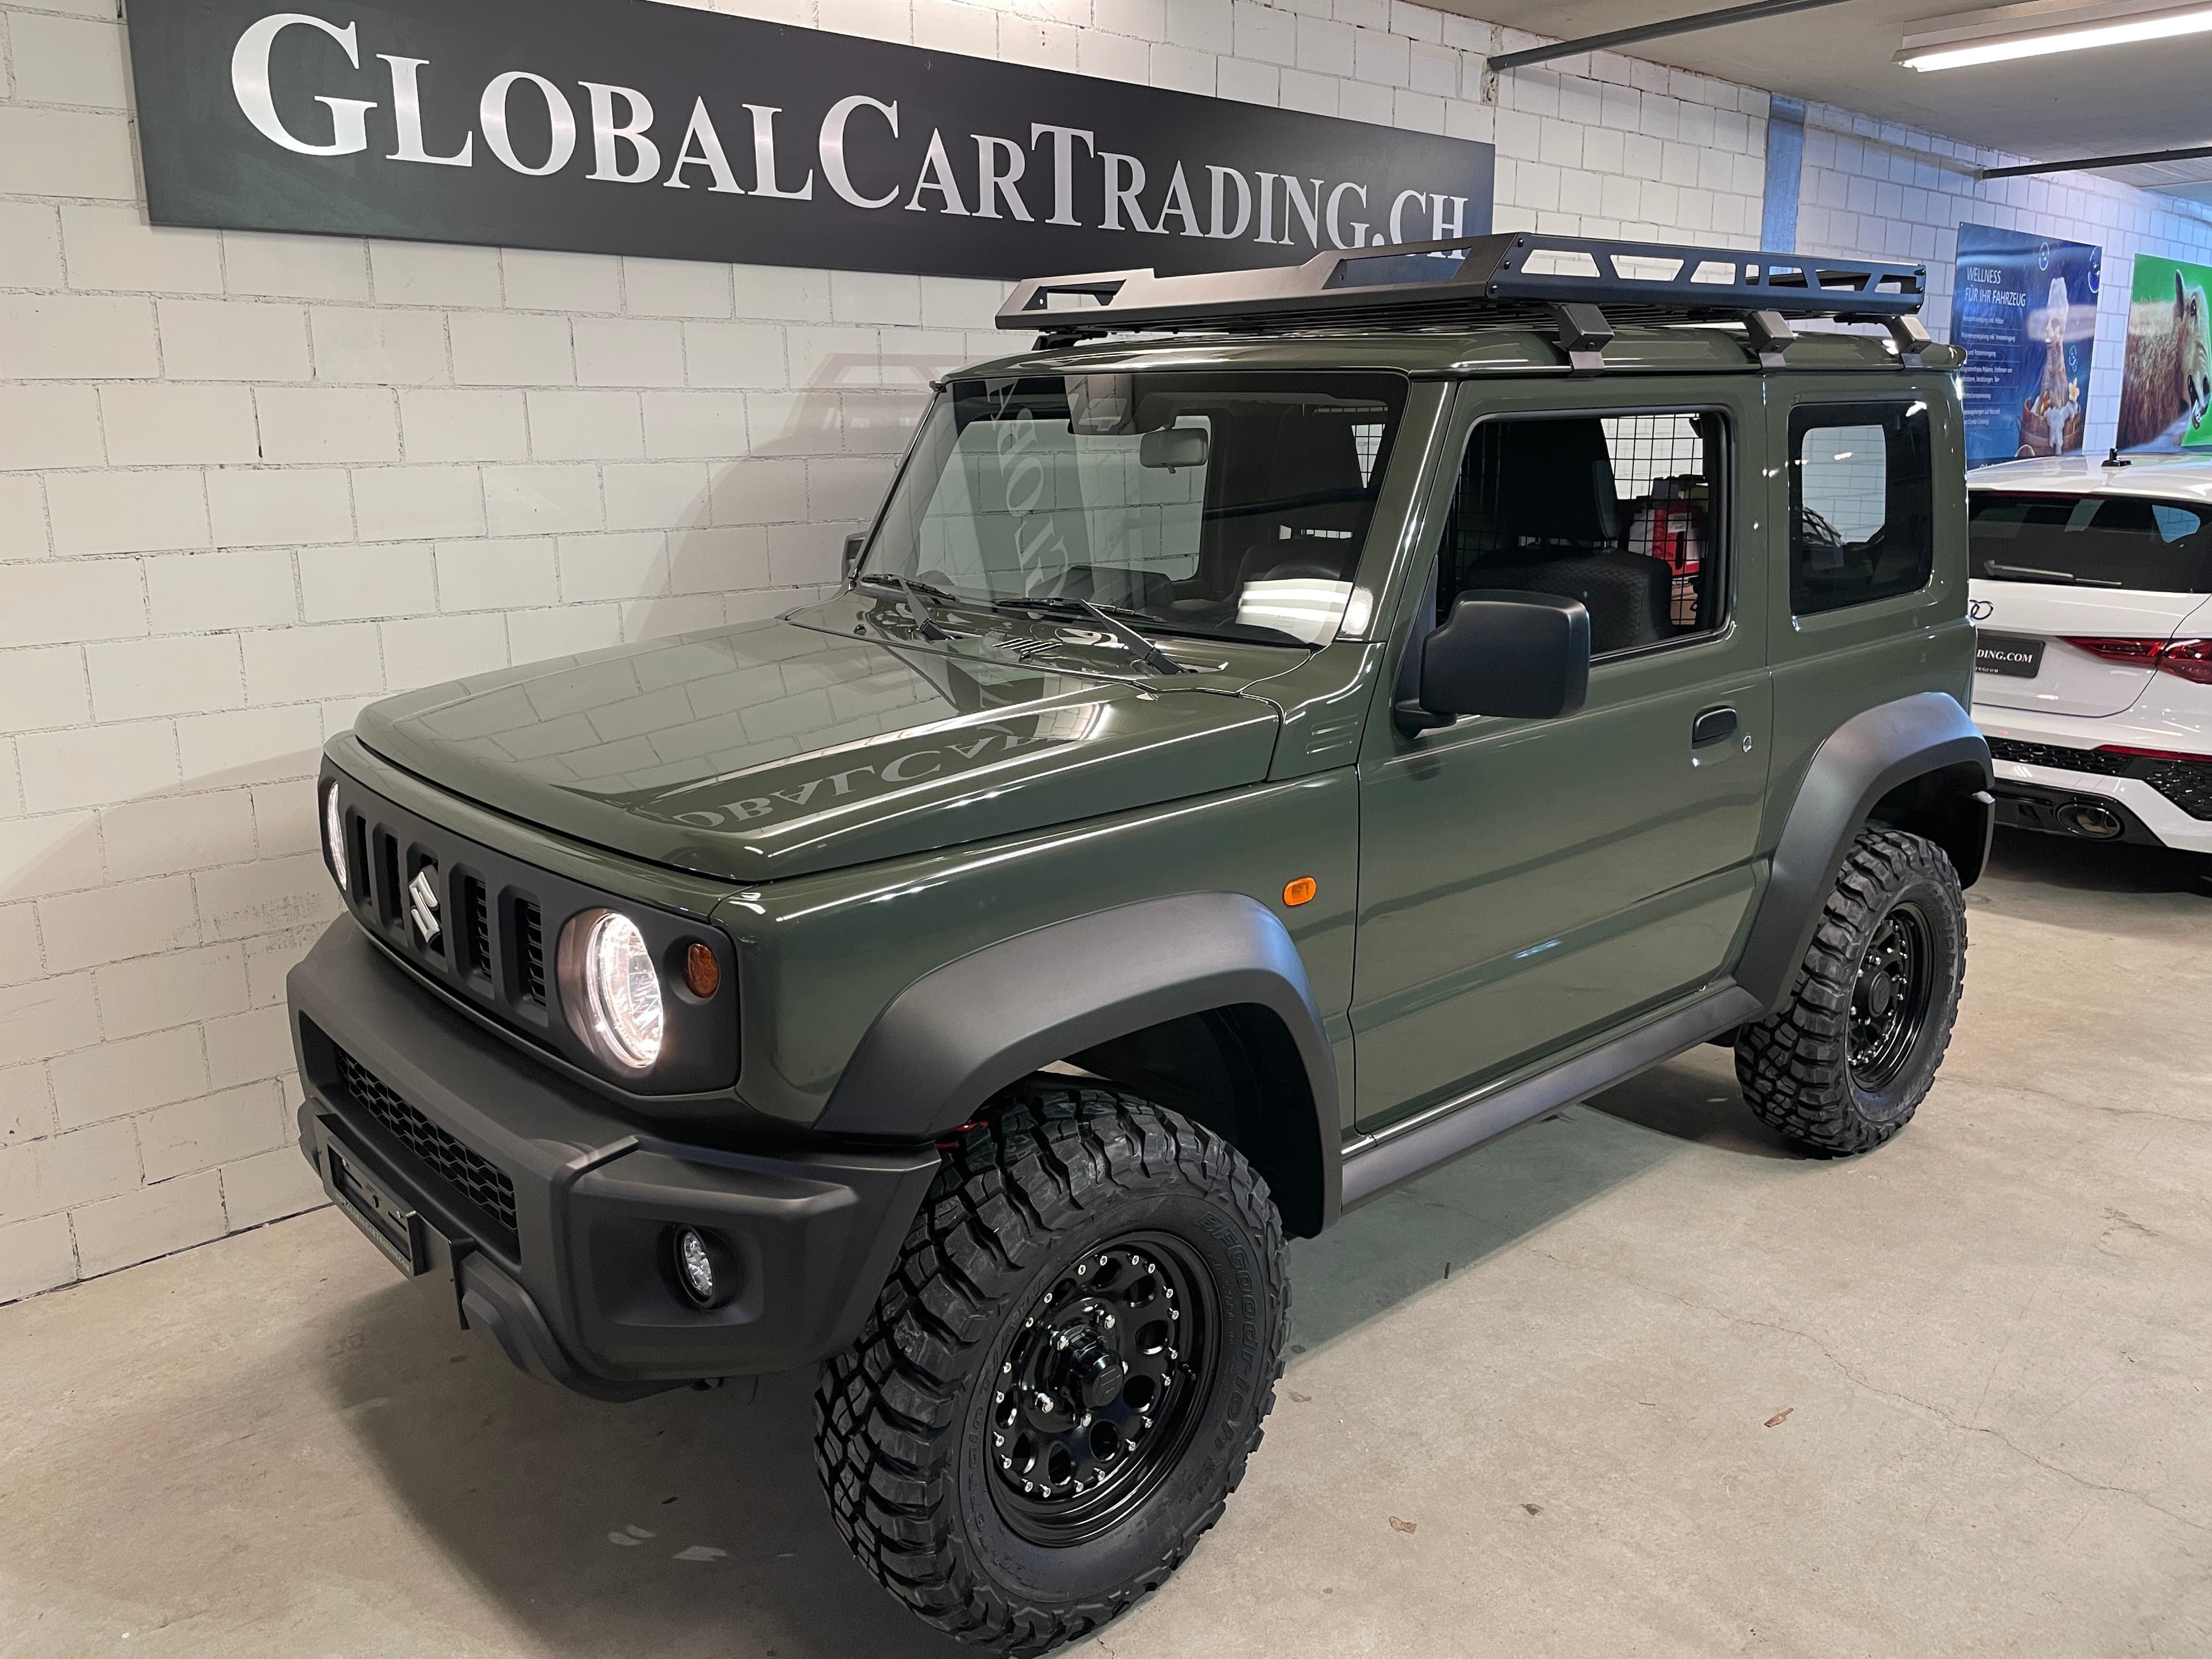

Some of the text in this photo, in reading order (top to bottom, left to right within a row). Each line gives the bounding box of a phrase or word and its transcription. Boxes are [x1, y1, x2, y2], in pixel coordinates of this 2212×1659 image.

[1967, 267, 2001, 284] WELLNESS
[1965, 285, 2026, 306] FÜR IHR FAHRZEUG
[1977, 649, 2032, 662] DING.COM
